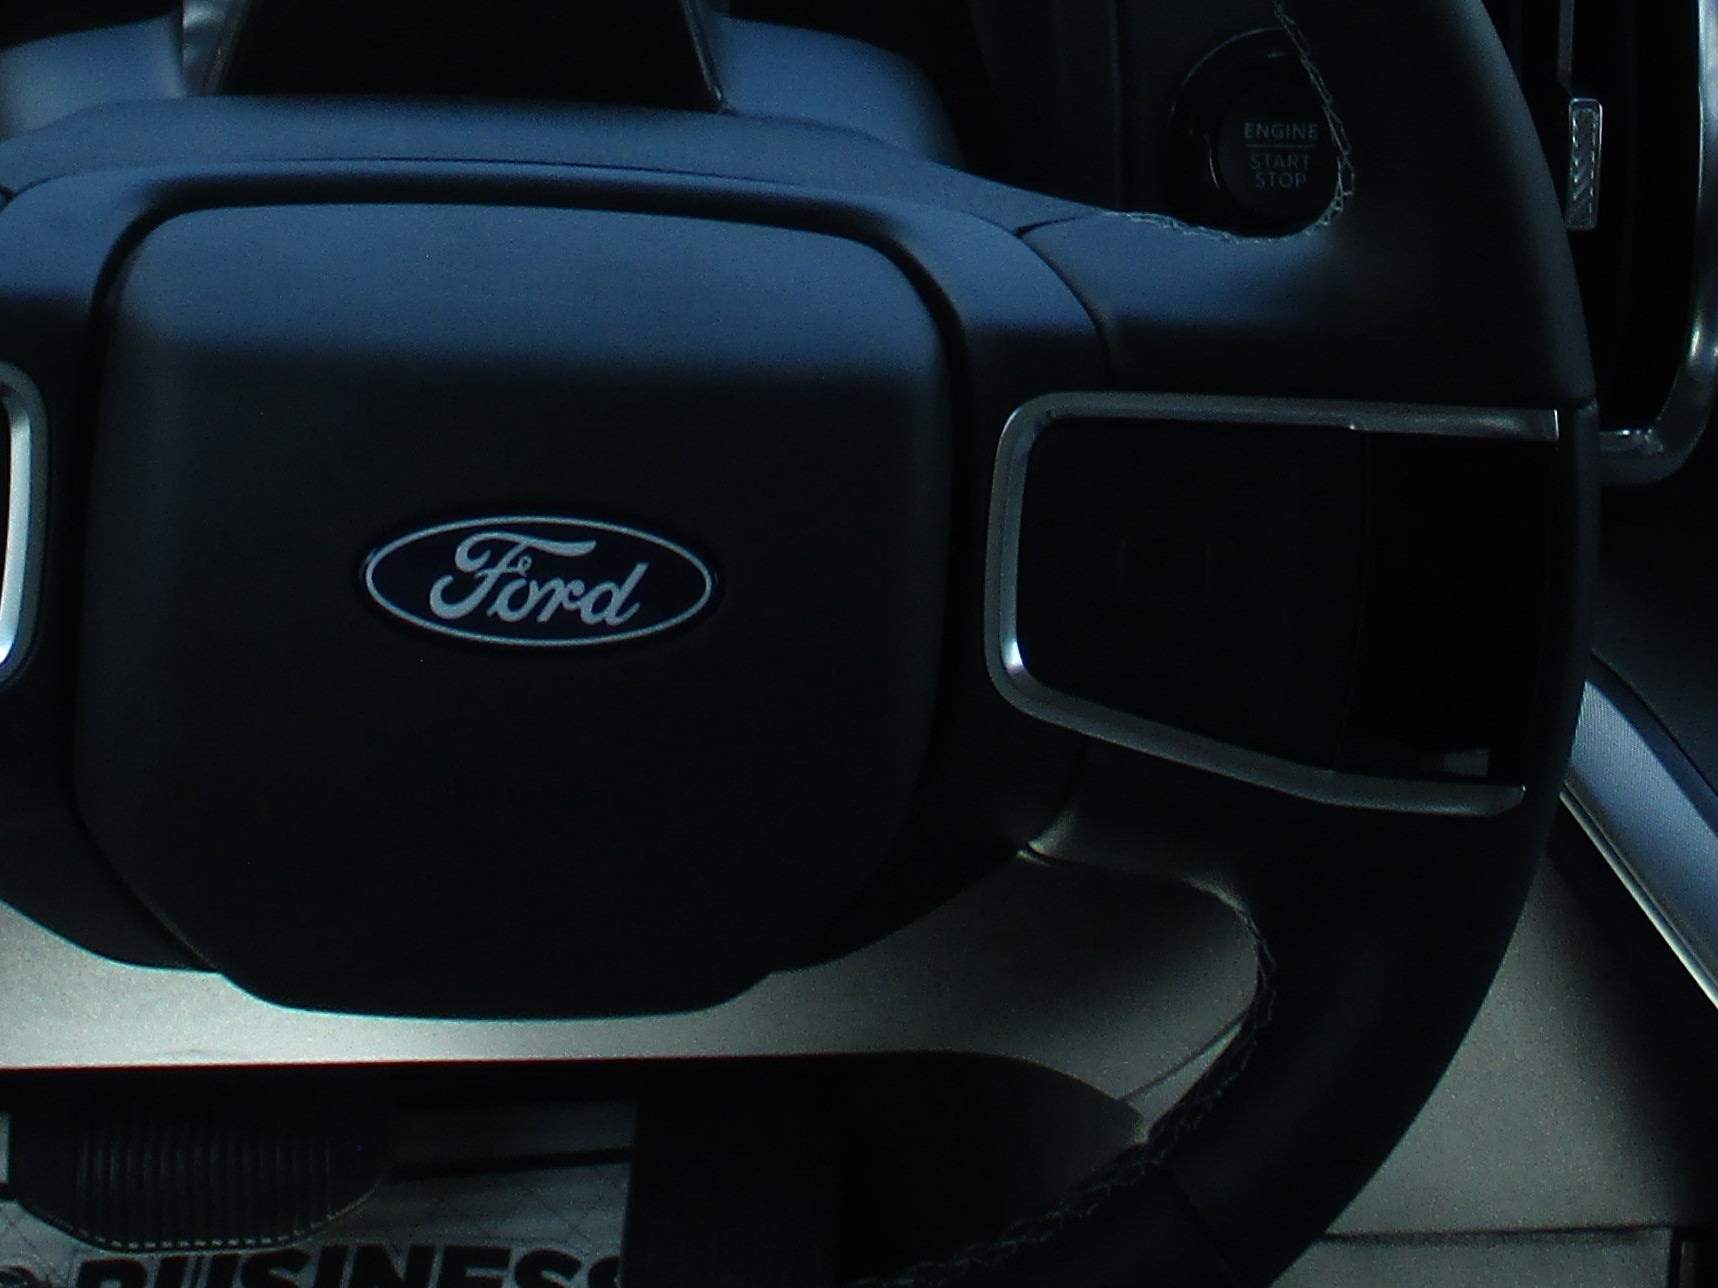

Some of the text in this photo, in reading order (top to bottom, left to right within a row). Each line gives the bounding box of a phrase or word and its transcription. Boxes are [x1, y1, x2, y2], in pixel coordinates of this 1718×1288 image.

[1244, 122, 1319, 140] ENGINE
[1250, 153, 1311, 171] START
[1254, 172, 1307, 189] STOP
[429, 531, 649, 626] Ford
